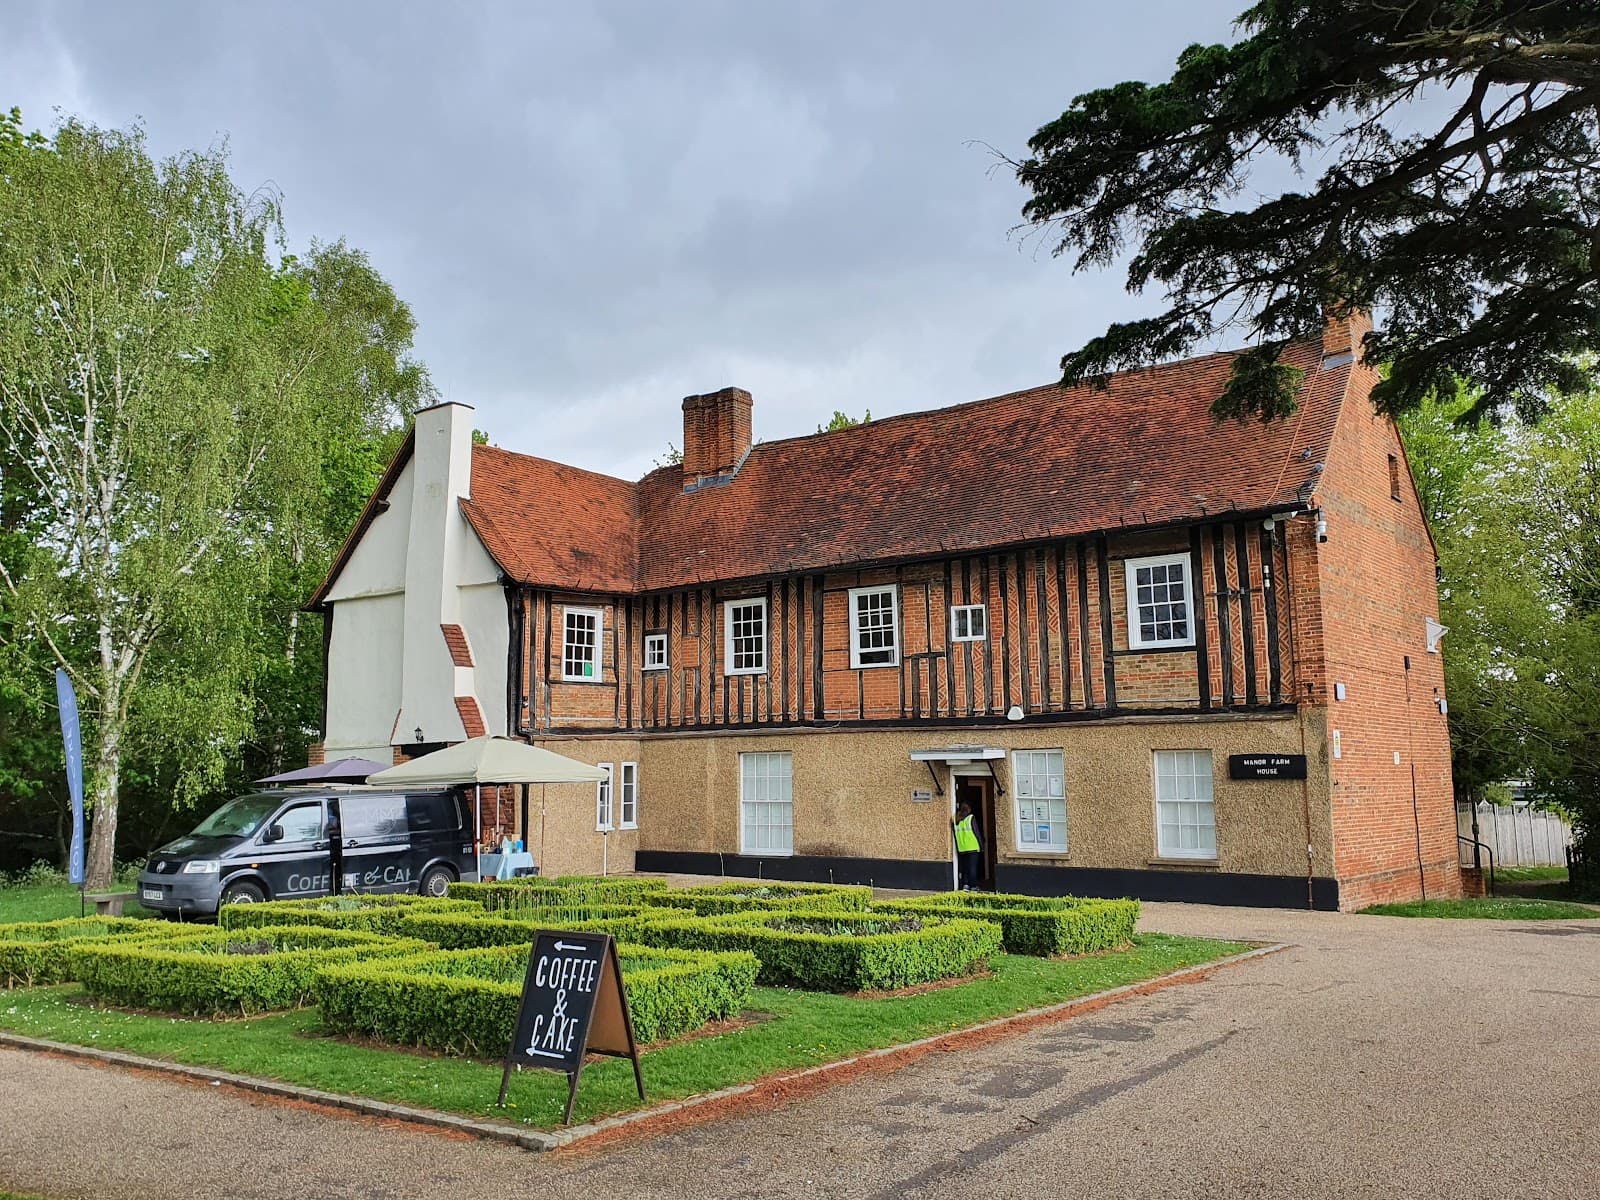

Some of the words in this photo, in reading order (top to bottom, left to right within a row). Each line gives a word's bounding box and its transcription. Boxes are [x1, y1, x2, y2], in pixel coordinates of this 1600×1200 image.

[287, 872, 360, 892] COFFE
[364, 865, 382, 885] &
[535, 955, 597, 992] COFFEE
[553, 988, 567, 1019] &
[530, 1014, 579, 1052] CAKE
